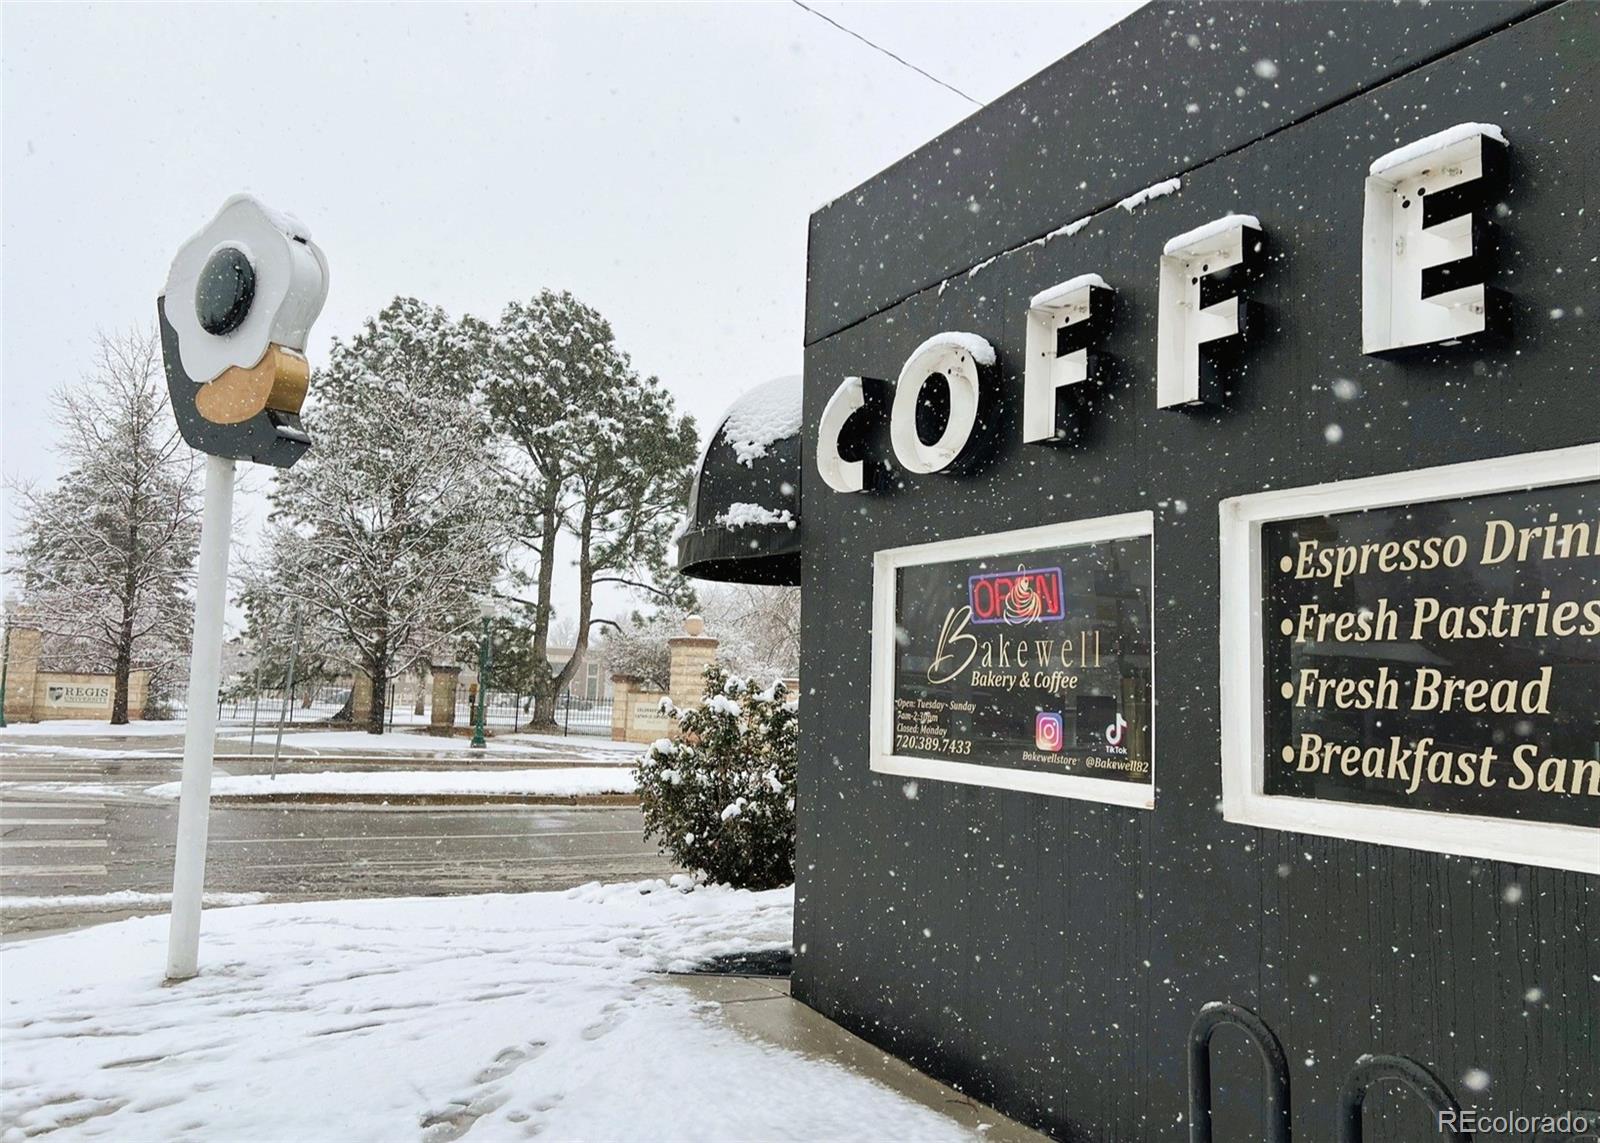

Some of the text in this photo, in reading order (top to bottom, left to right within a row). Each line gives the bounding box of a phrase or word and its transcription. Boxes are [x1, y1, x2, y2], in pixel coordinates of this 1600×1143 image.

[816, 128, 1502, 493] COFFE
[1294, 533, 1467, 588] Espresso
[1295, 589, 1600, 643] Fresh Pastries
[927, 605, 1102, 684] Bakewell
[65, 686, 109, 697] REGIS
[971, 670, 1078, 693] Bakery & Coffee
[1295, 666, 1553, 714] Fresh Bread
[897, 698, 916, 709] Open:
[949, 700, 977, 714] Sunday
[896, 735, 972, 755] 720.389.7433
[897, 723, 947, 738] Closed: Monday
[1022, 751, 1149, 773] Bakewellstore @Bakewell82
[1296, 733, 1498, 795] Breakfast
